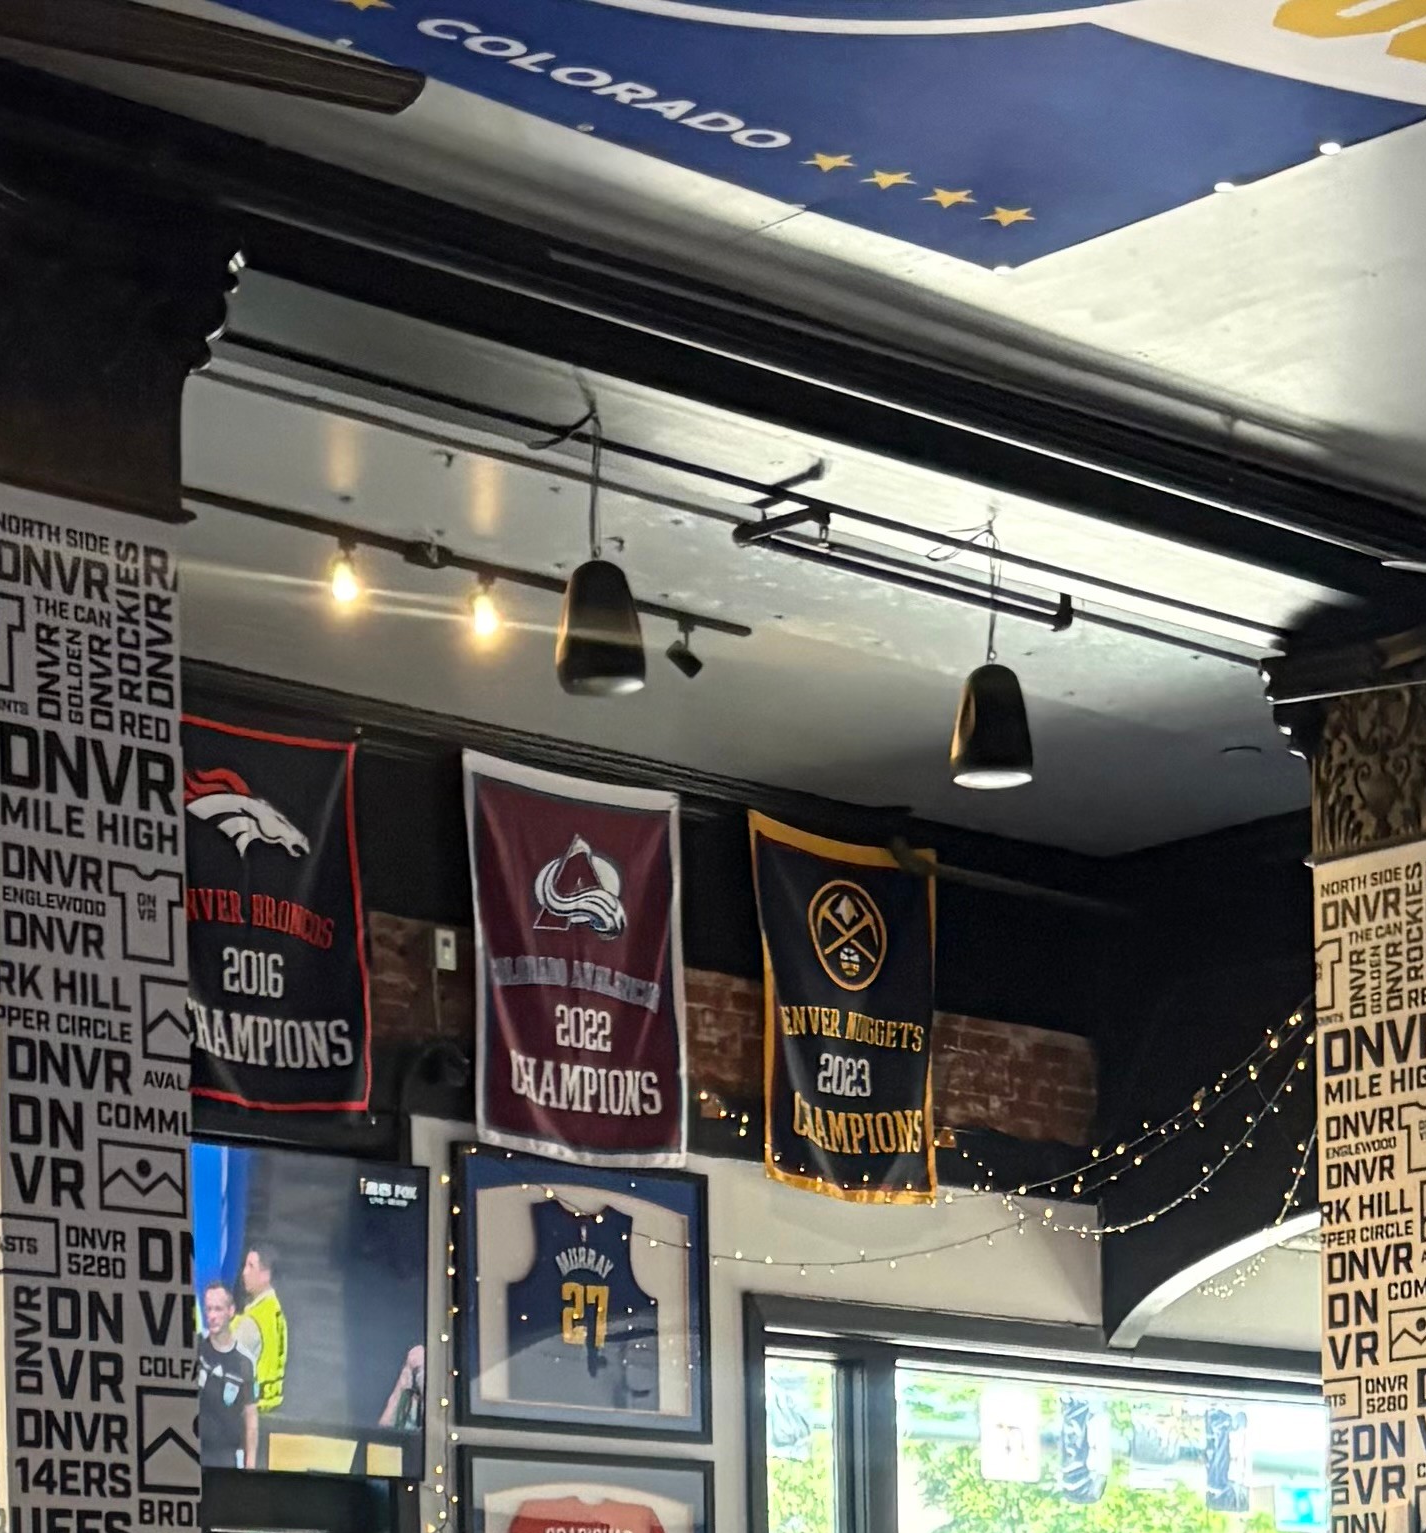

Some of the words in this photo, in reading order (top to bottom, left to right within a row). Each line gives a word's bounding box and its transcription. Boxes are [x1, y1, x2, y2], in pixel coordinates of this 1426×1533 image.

[417, 18, 791, 149] COLORADO
[66, 529, 110, 555] SIDE
[33, 596, 69, 621] THE
[74, 604, 111, 630] CAN
[115, 539, 142, 704] ROCKIES
[35, 622, 60, 721] DNVR
[143, 596, 175, 710] DNVR
[89, 633, 113, 732] DNVR
[0, 792, 85, 839] MILE
[96, 812, 179, 857] HIGH
[2, 841, 104, 894] DNVR
[1320, 873, 1367, 898] NORTH
[1371, 867, 1402, 886] SIDE
[2, 885, 107, 919] ENGLEWOOD
[252, 893, 334, 950] BRONCOS
[1323, 886, 1402, 933] DNVR
[1405, 861, 1423, 982] ROCKIES
[4, 910, 104, 962] DNVR
[53, 969, 132, 1013] HILL
[223, 946, 284, 999] 2016
[56, 1011, 133, 1044] CIRCLE
[555, 1004, 611, 1052] 2022
[845, 1011, 924, 1052] NUGGETS
[8, 1036, 132, 1095] DNVR
[510, 1049, 662, 1117] CHAMPIONS
[818, 1053, 871, 1097] 2023
[1325, 1073, 1382, 1105] MILE
[1325, 1107, 1394, 1142] DNVR
[1325, 1137, 1396, 1160] ENGLEWOOD
[1327, 1155, 1394, 1190] DNVR
[1359, 1189, 1413, 1218] HILL
[65, 1226, 126, 1252] DNVR
[1360, 1220, 1413, 1244] CIRCLE
[67, 1254, 126, 1280] 5280
[555, 1247, 614, 1279] MURRAY
[1327, 1244, 1413, 1285] DNVR
[562, 1282, 609, 1348] 27
[16, 1286, 42, 1395] DNVR
[1366, 1374, 1408, 1395] DNVR
[1367, 1394, 1408, 1414] 5280
[16, 1408, 129, 1455] DNVR
[14, 1458, 132, 1499] 14ERS
